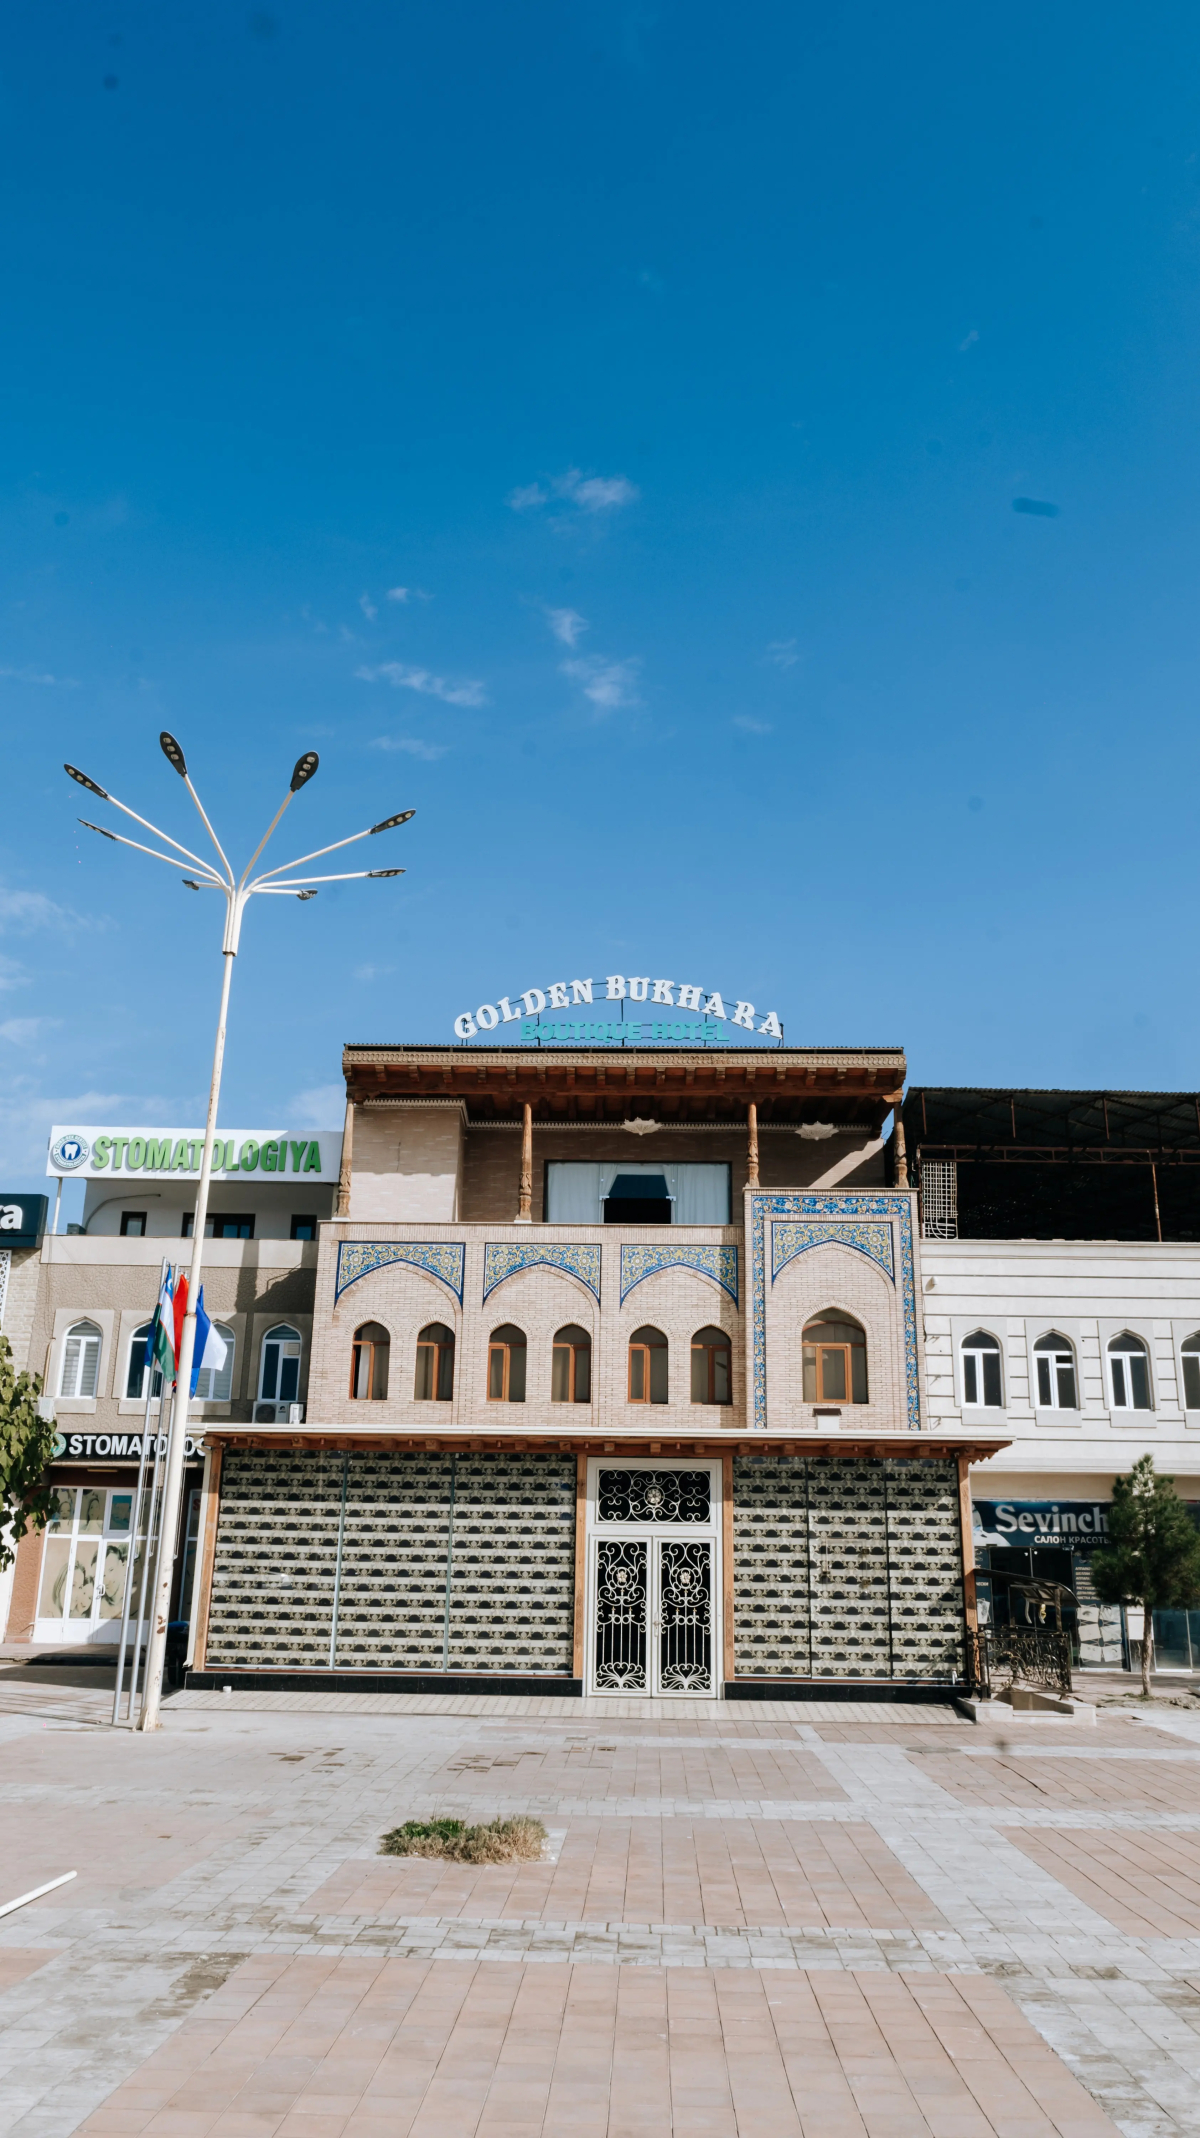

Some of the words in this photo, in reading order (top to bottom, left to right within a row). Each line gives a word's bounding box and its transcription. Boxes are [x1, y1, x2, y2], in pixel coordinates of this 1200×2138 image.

[454, 978, 594, 1040] GOLDEN
[605, 974, 784, 1040] BUKHARA
[520, 1021, 642, 1043] BOUTIQUE
[652, 1021, 730, 1042] HOTEL
[93, 1135, 322, 1173] STOMATOLOGIYA
[995, 1504, 1110, 1533] Sevinch
[1034, 1535, 1067, 1545] САЛОН
